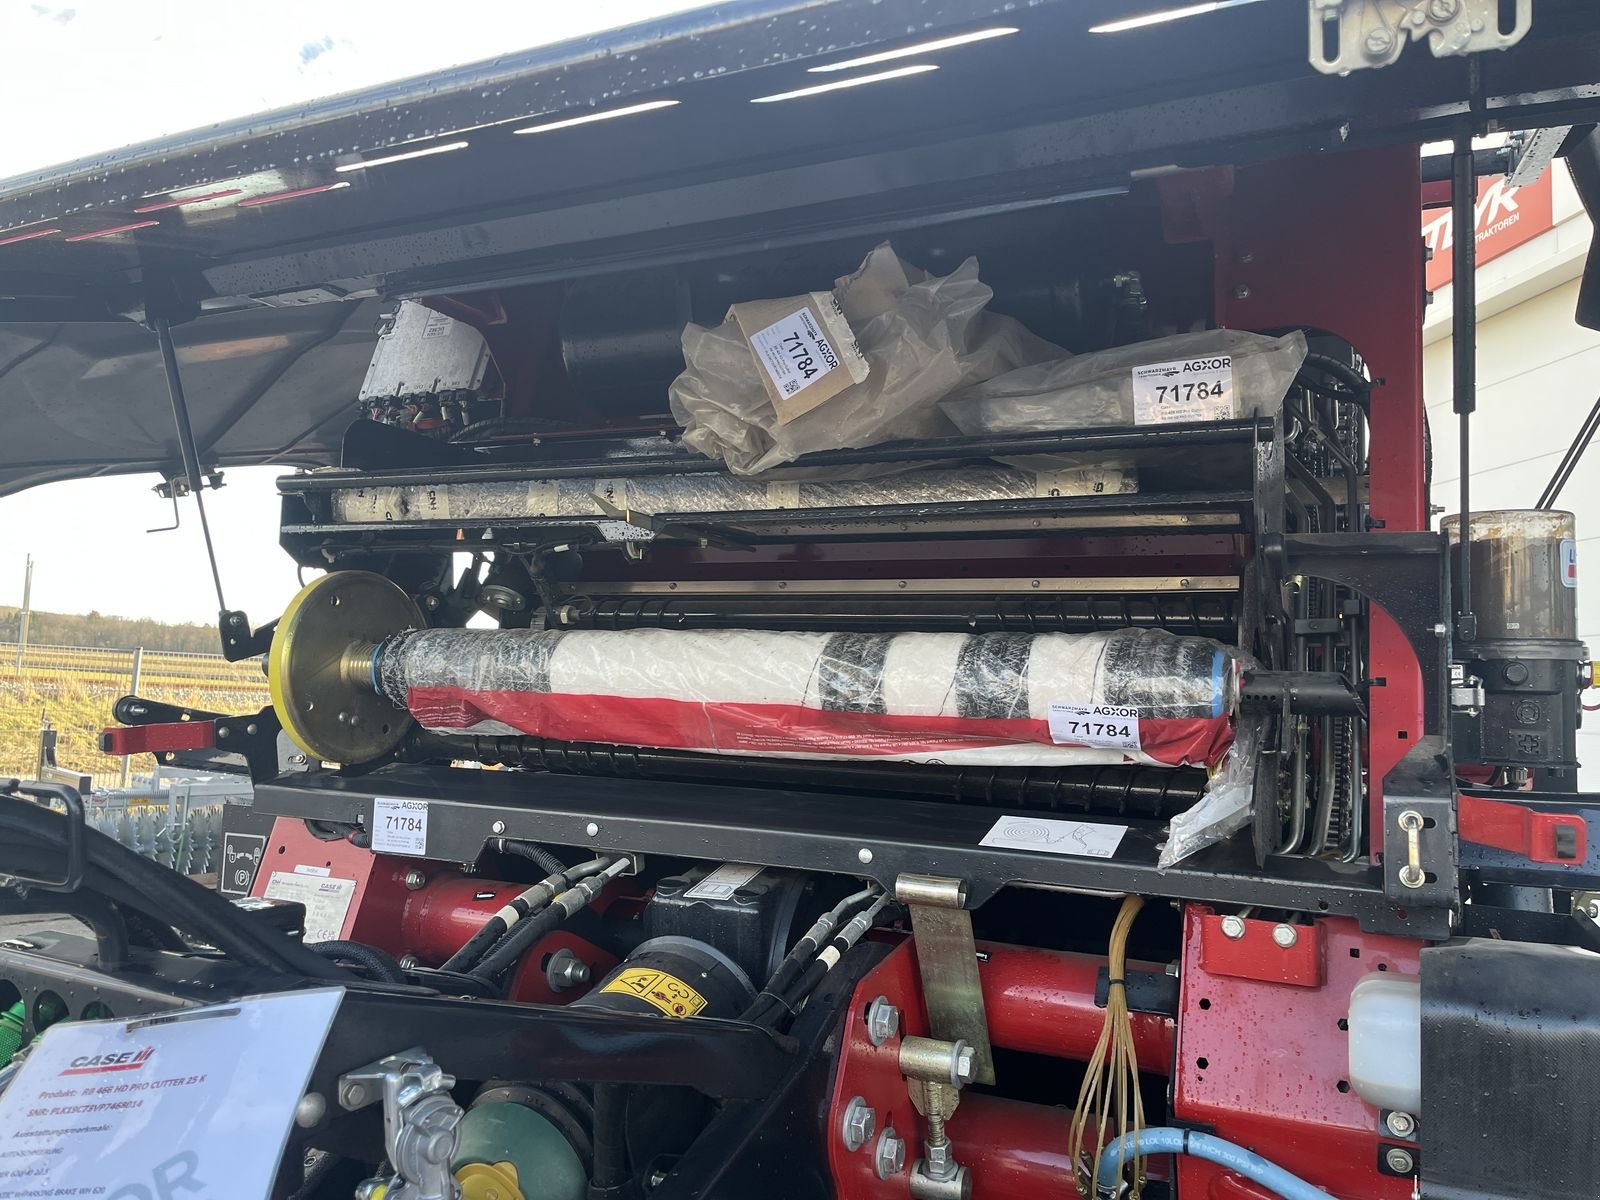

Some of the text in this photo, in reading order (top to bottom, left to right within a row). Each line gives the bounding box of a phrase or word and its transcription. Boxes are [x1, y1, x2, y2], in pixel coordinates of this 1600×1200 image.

[1475, 212, 1520, 244] TRAKTOREN
[783, 331, 818, 380] 71784
[815, 338, 838, 370] AGXOR
[1182, 358, 1231, 373] AGXOR
[1155, 380, 1224, 404] 71784
[1093, 706, 1138, 718] AGXOR
[1068, 721, 1131, 738] 71784
[402, 801, 428, 811] AGXOR
[386, 816, 422, 832] 71784
[70, 1051, 134, 1068] CASE
[39, 1089, 77, 1100] Produkt:
[114, 1084, 129, 1093] HD
[129, 1082, 150, 1092] PRO
[151, 1077, 186, 1089] CUTTER
[186, 1075, 199, 1085] 25
[54, 1187, 77, 1196] BRAKE
